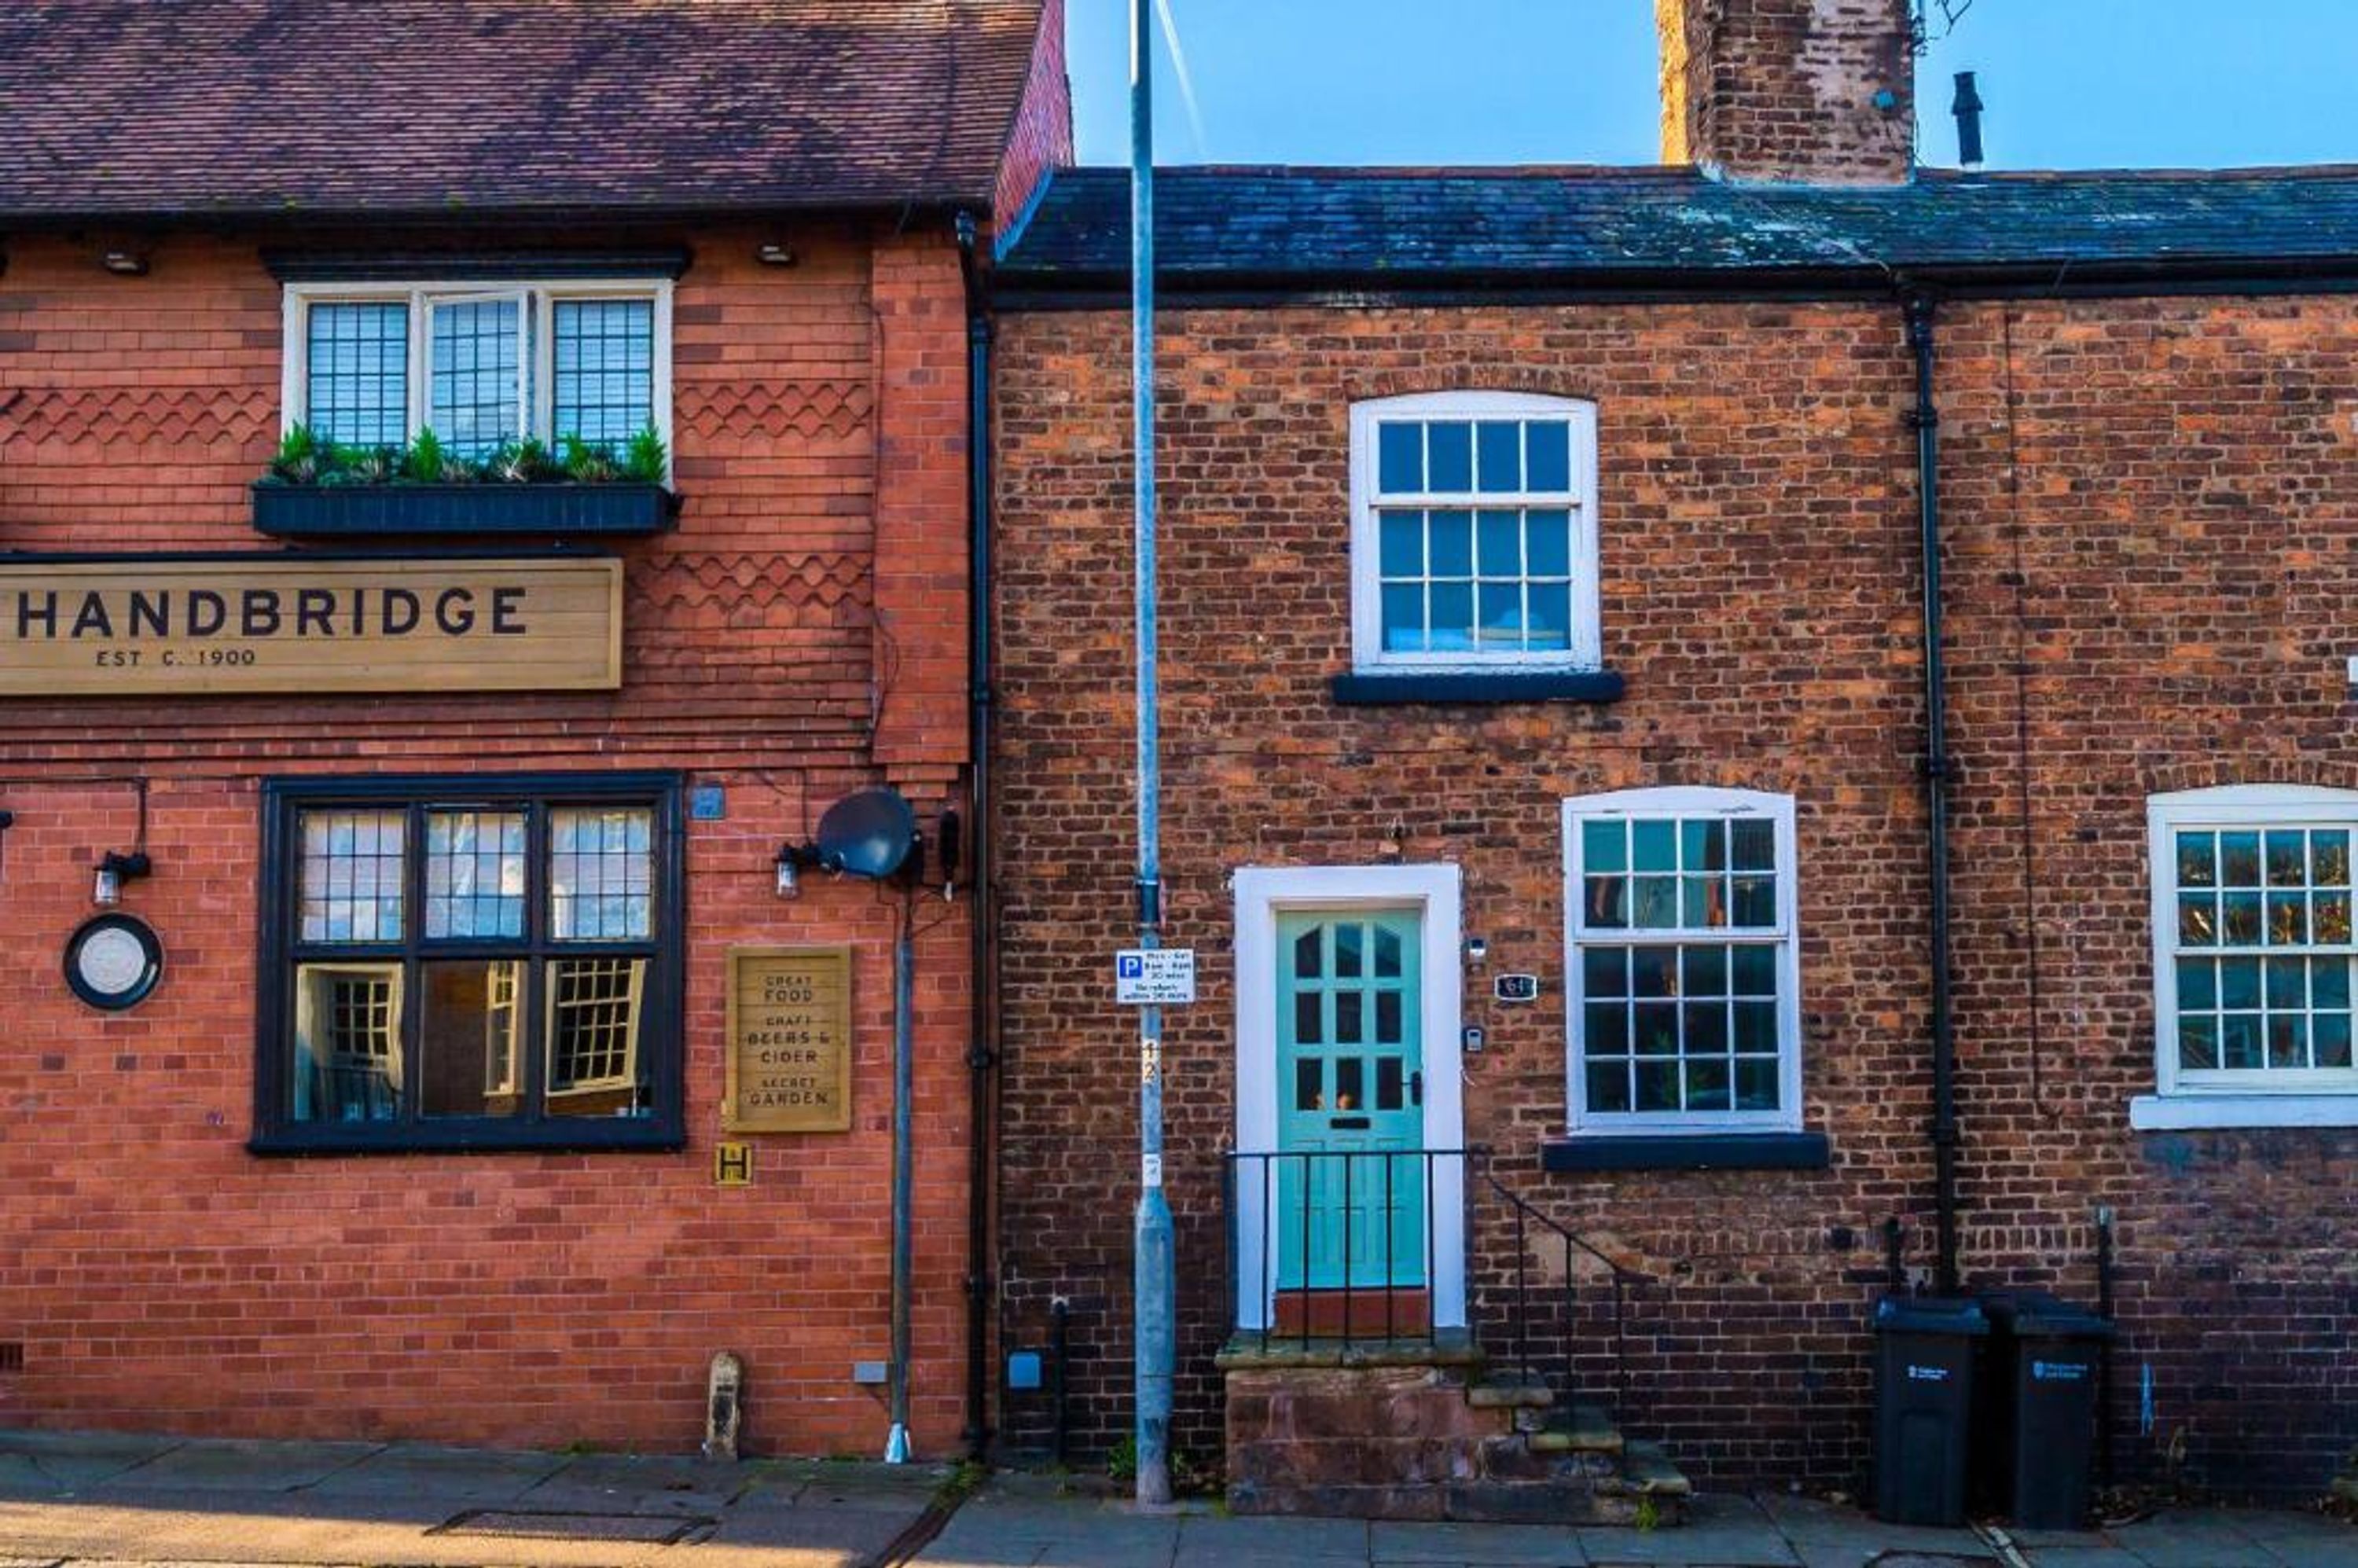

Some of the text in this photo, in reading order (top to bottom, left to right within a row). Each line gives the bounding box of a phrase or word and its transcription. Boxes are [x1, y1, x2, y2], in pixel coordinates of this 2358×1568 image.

[17, 587, 526, 638] HANDBRIDGE
[96, 651, 141, 666] EST
[200, 649, 255, 666] 1900
[1126, 958, 1139, 976] P
[766, 976, 811, 986] GREAT
[765, 990, 811, 1002] FOOD
[766, 1015, 811, 1026] CRAFT
[747, 1031, 830, 1045] BEERS &
[760, 1051, 817, 1063] CIDER
[762, 1078, 815, 1088] SECRET
[750, 1091, 828, 1106] GARDEN
[720, 1147, 747, 1180] H
